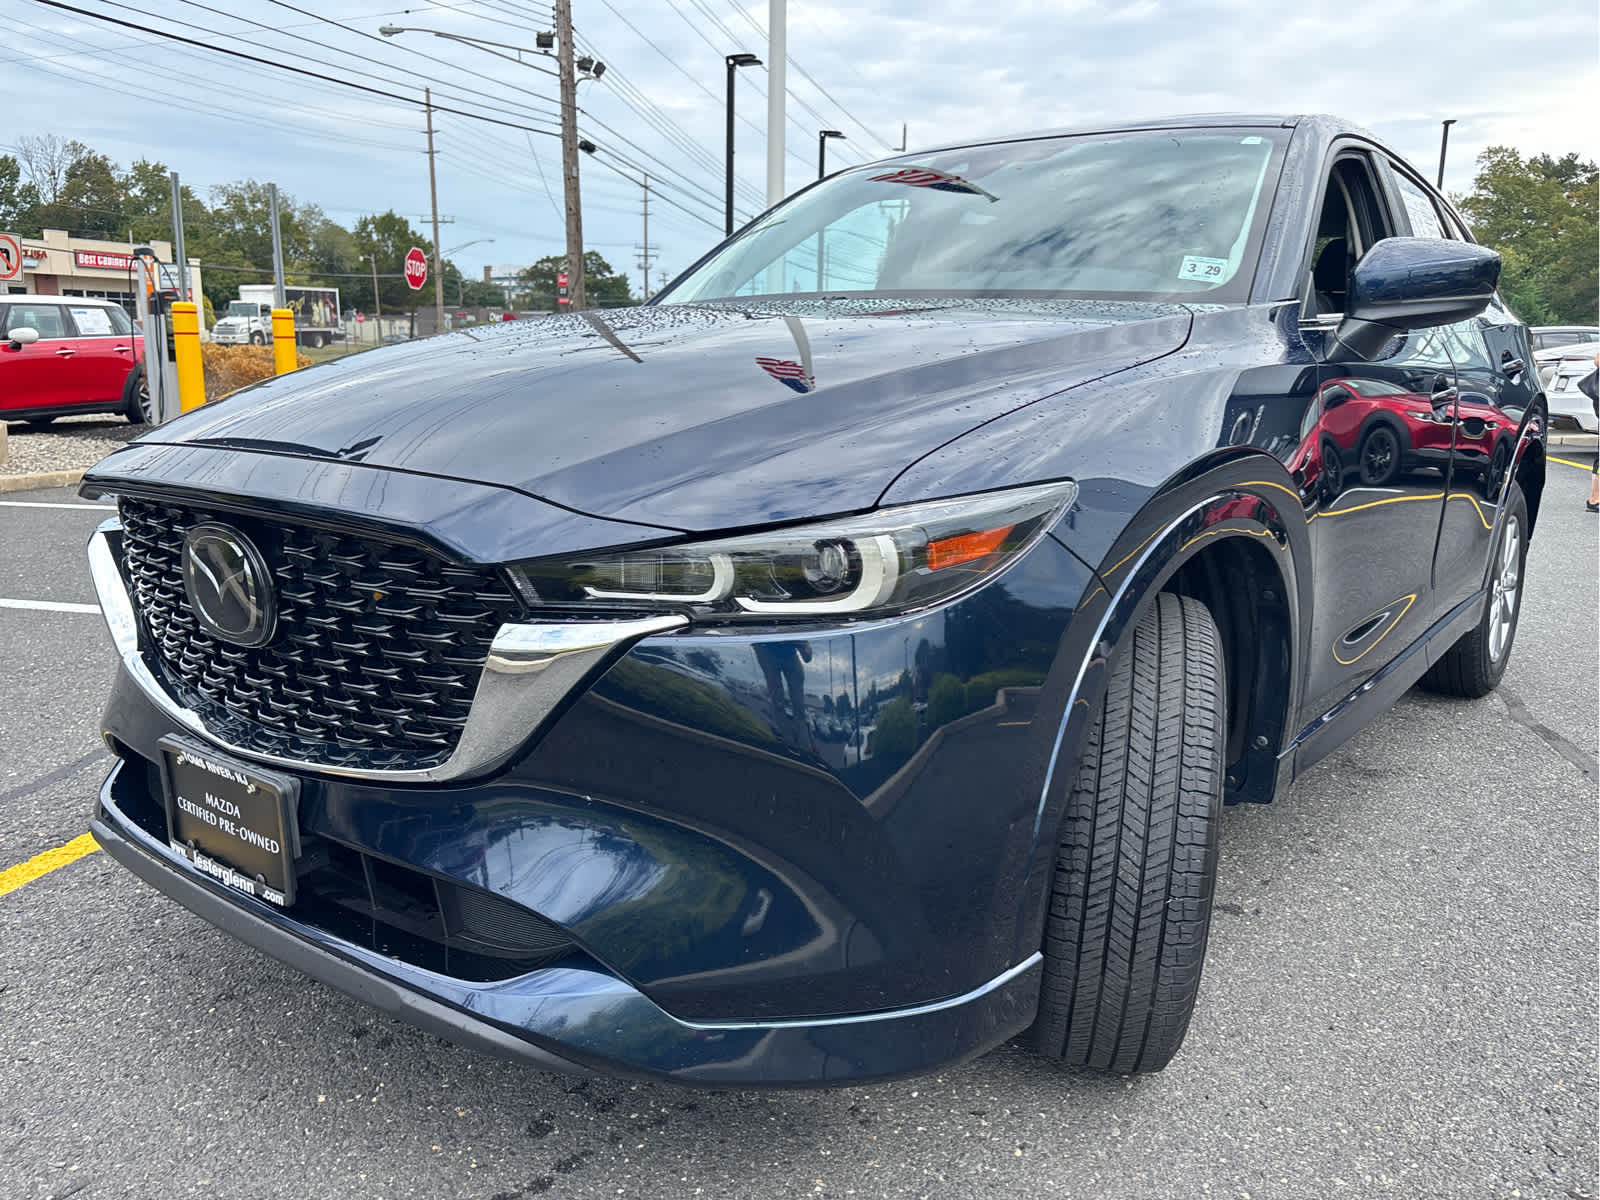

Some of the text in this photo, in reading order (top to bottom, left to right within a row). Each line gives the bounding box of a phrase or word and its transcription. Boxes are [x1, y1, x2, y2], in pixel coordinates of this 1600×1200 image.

[407, 259, 426, 278] STOP
[1187, 263, 1221, 276] 3 29
[181, 751, 206, 770] TOMS
[234, 772, 249, 786] NJ
[205, 792, 241, 819] MAZDA
[177, 796, 280, 854] CERTIFIED PRE-OWNED
